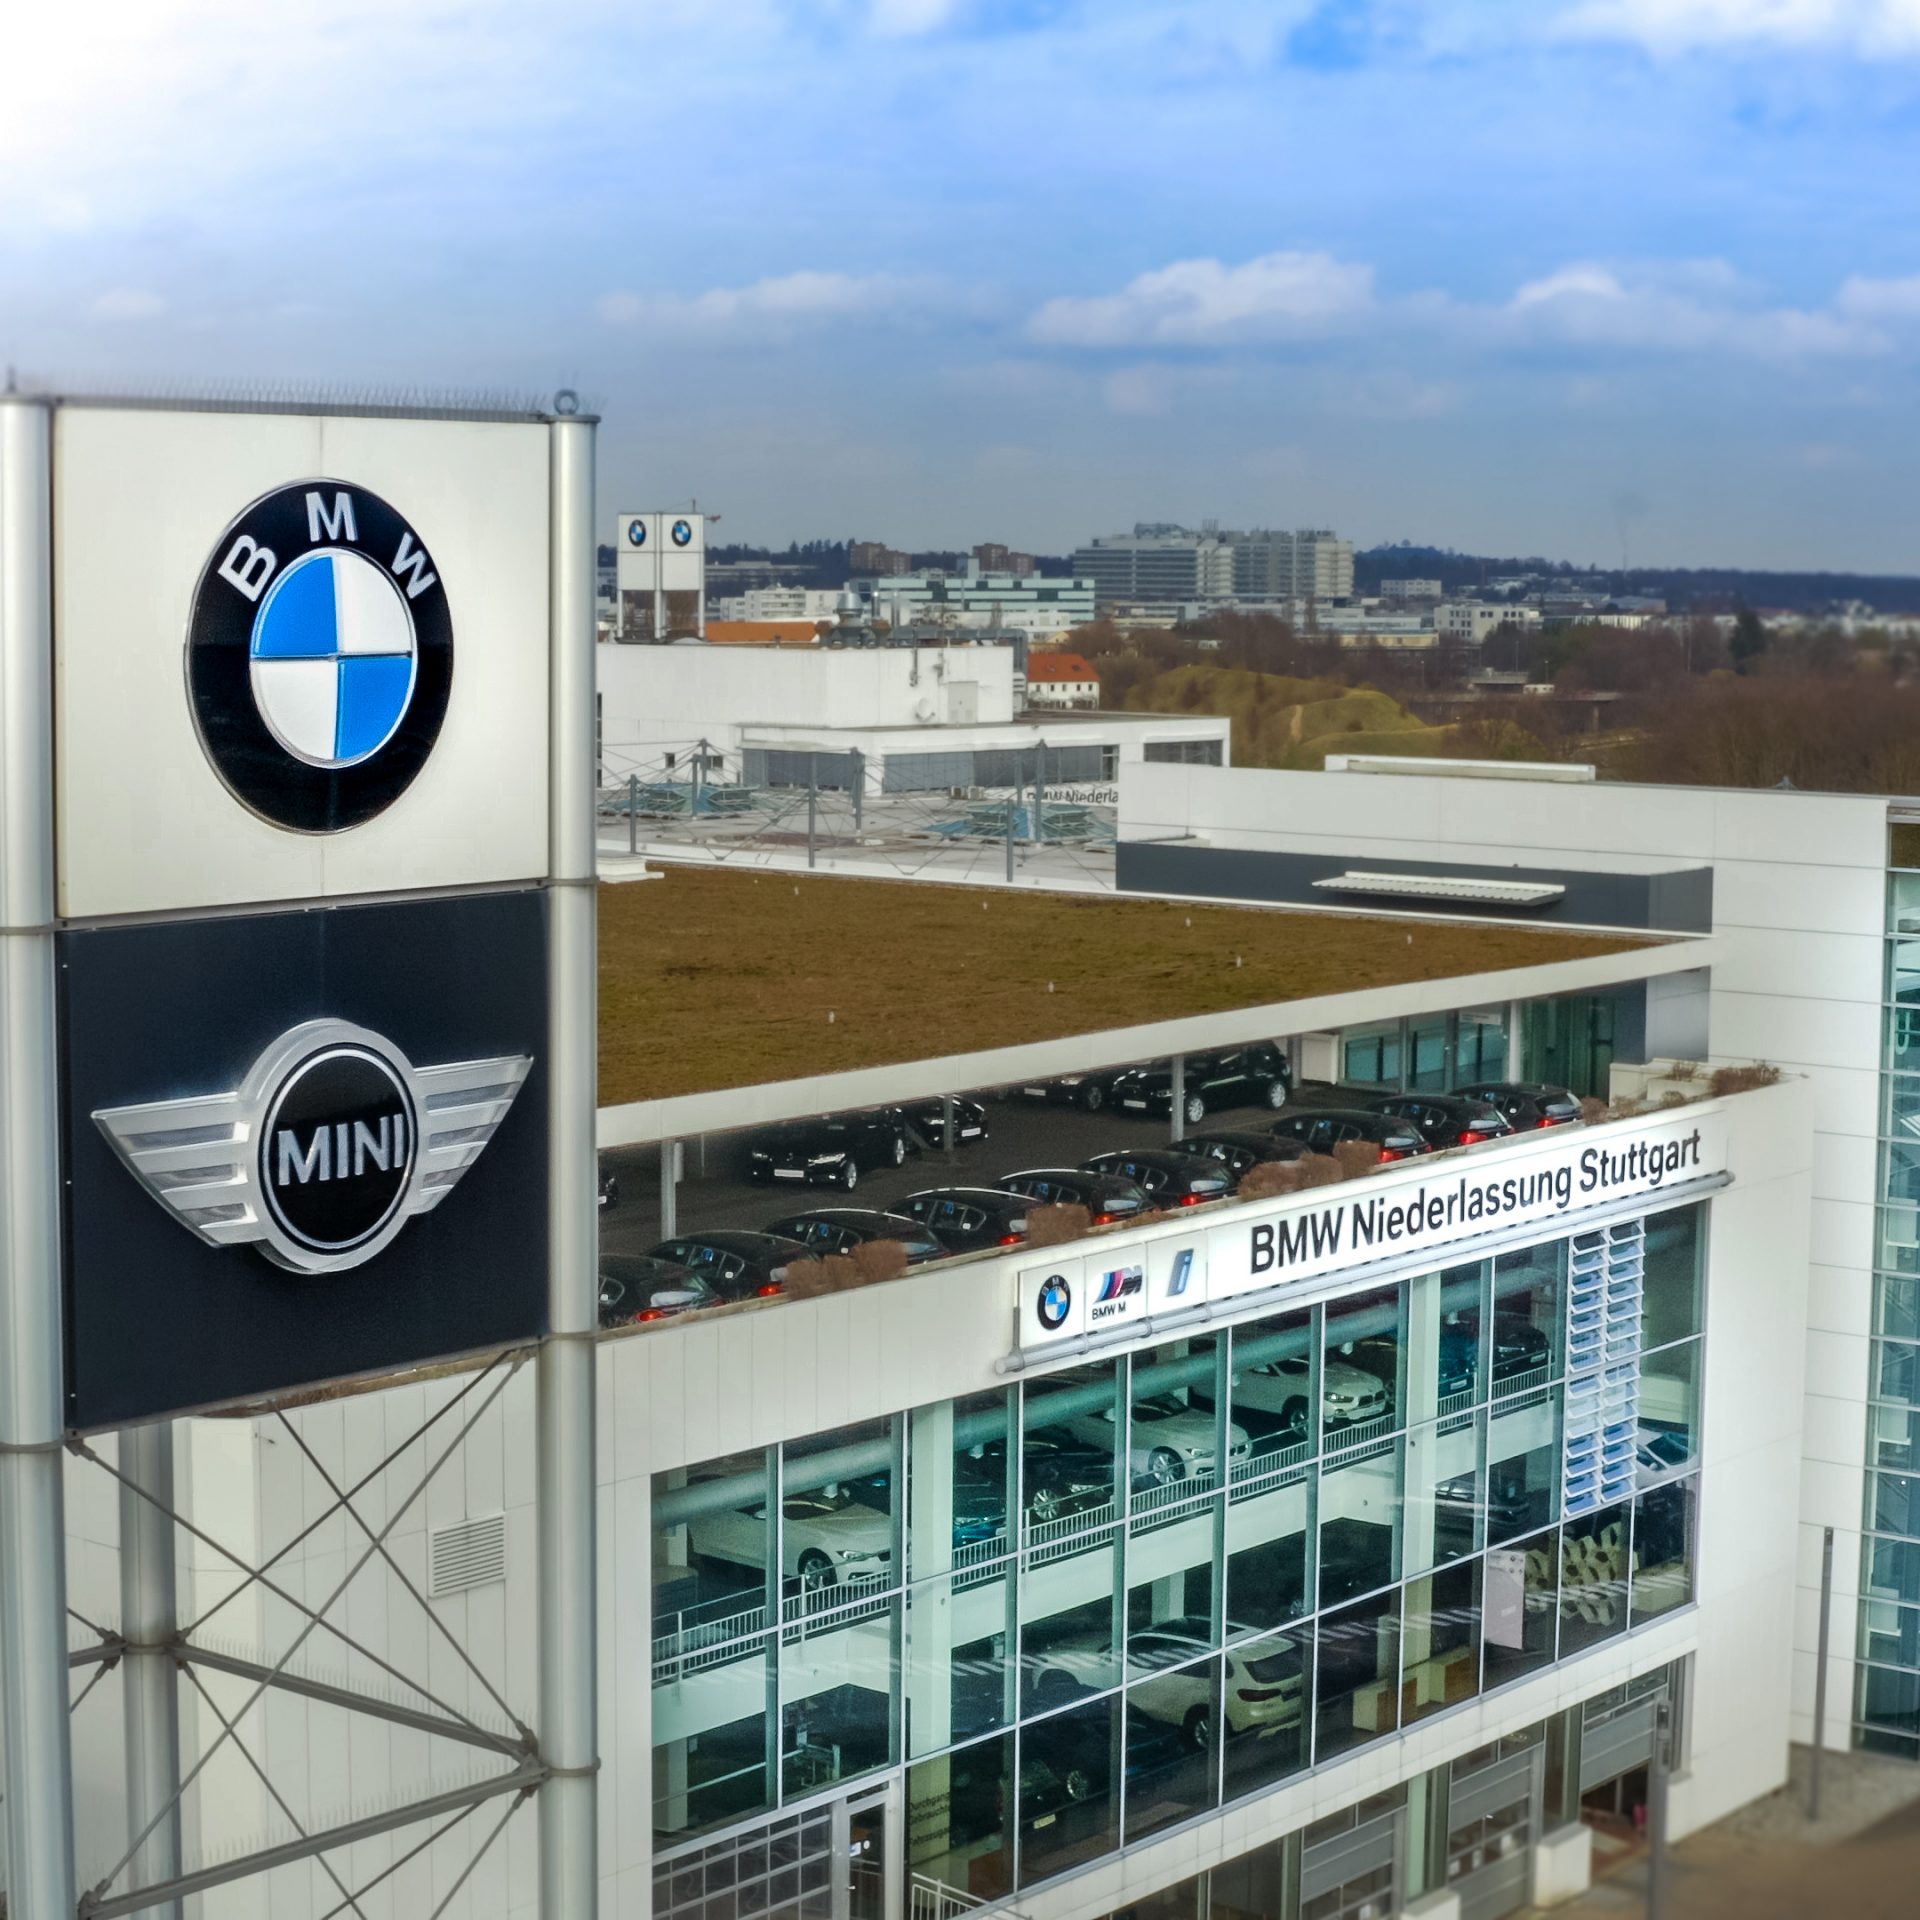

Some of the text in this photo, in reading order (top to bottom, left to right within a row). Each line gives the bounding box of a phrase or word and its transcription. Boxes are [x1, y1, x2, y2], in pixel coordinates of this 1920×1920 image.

[217, 491, 437, 602] BMW
[278, 1113, 405, 1186] MINI
[1251, 1128, 1701, 1274] BMW Niederlassung Stuttgart
[1092, 1301, 1127, 1321] BMW M
